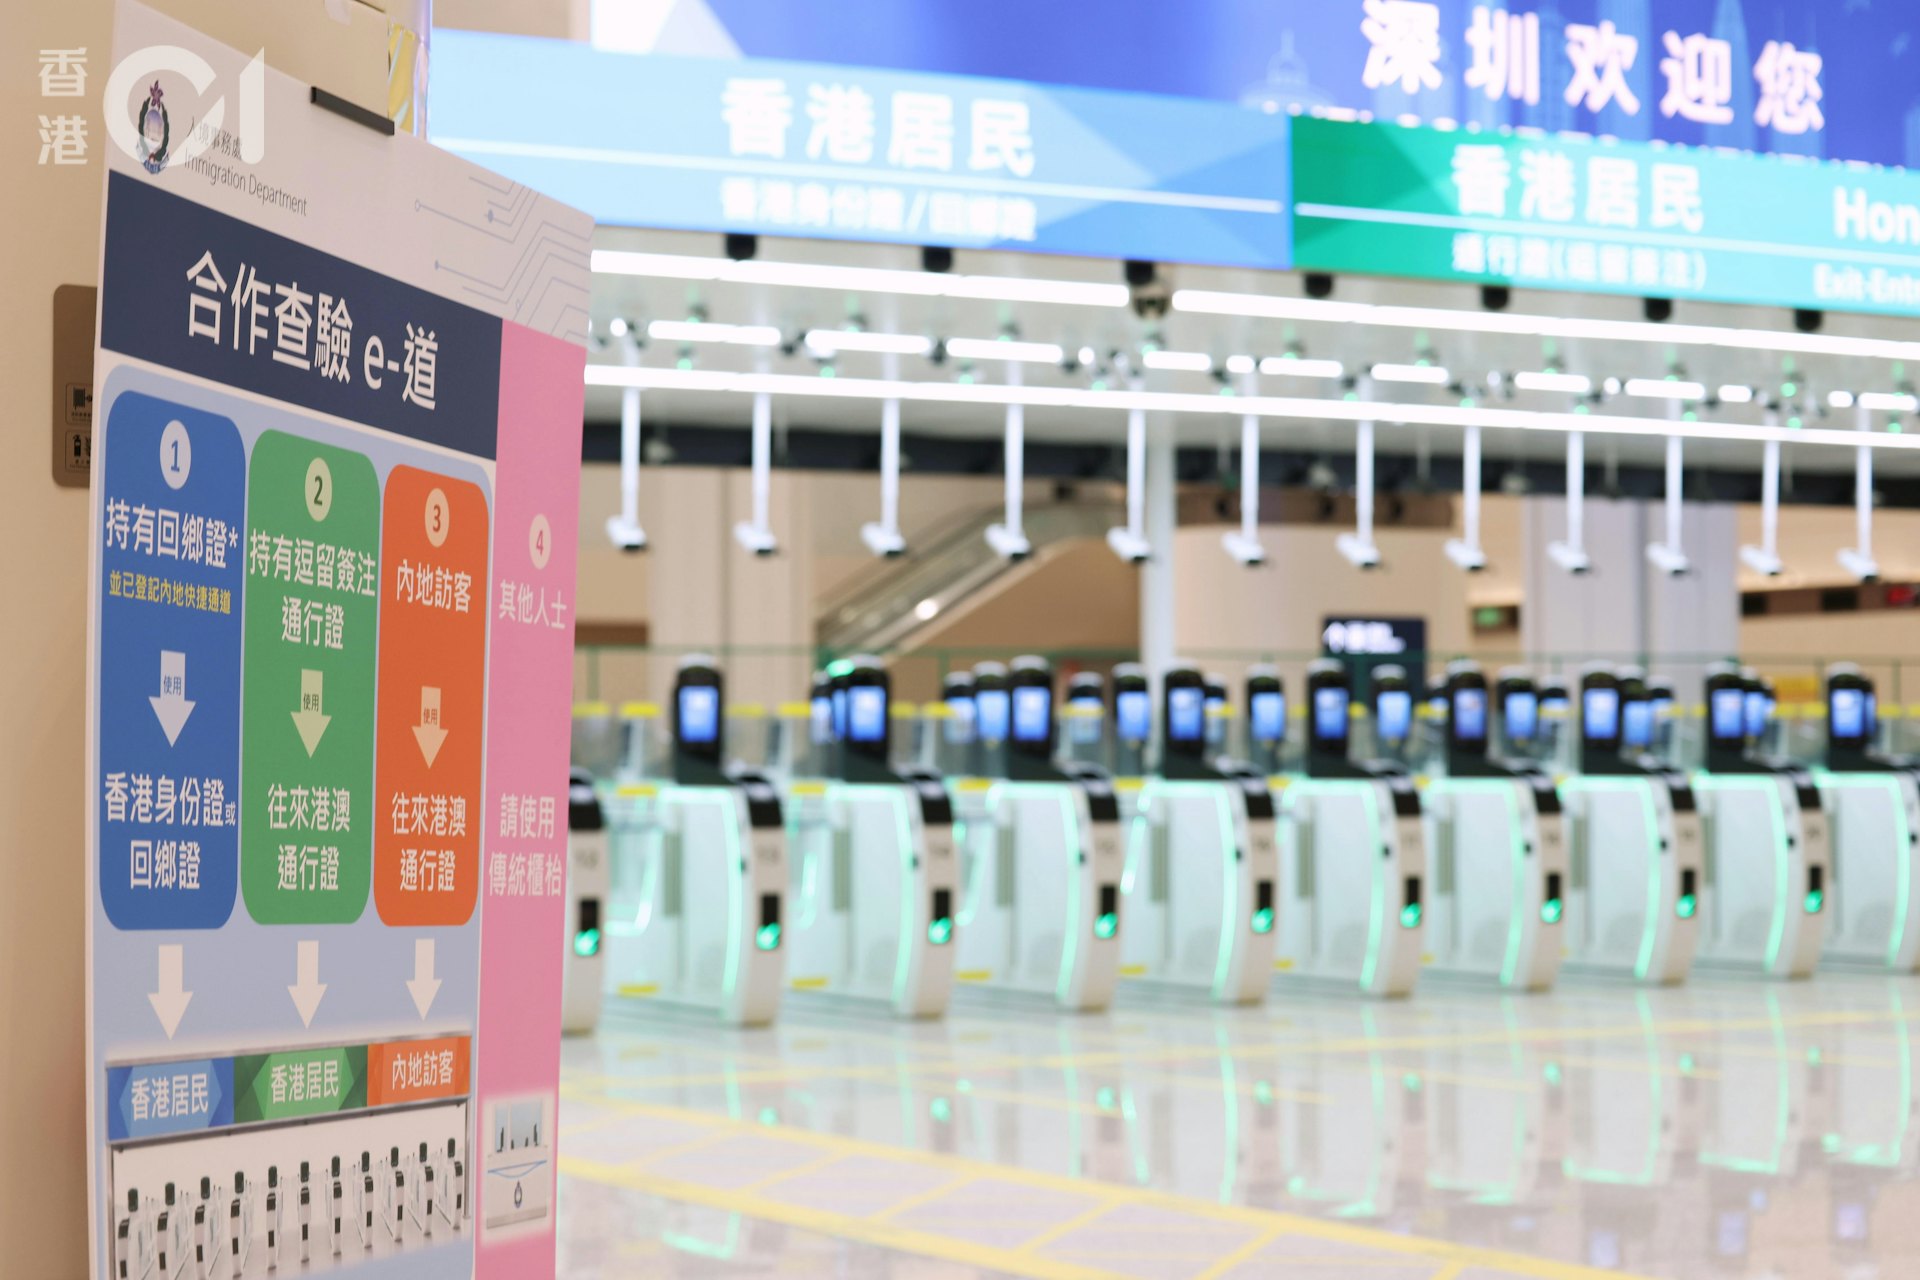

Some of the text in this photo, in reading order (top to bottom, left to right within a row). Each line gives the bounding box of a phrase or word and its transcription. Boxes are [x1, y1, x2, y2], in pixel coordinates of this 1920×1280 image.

[1361, 0, 1825, 134] 深圳欢迎您
[721, 78, 1035, 177] 香港居民
[184, 147, 307, 216] Immigration Department
[1451, 143, 1704, 233] 香港居民
[186, 250, 440, 411] 合作查驗 e-道
[170, 441, 181, 473] 1
[313, 475, 324, 506] 2
[432, 504, 441, 533] 3
[250, 528, 376, 597] 持有逗留簽注
[536, 529, 544, 556] 4
[282, 595, 344, 650] 通行證
[499, 579, 567, 630] 其他人士
[163, 675, 182, 696] 使用
[303, 693, 319, 712] 使用
[423, 708, 438, 726] 使用
[267, 783, 351, 832] 往來港澳
[392, 791, 466, 837] 往來港澳
[500, 792, 555, 839] 請使用
[130, 840, 200, 890] 回鄉證
[277, 844, 339, 891] 通行證
[400, 848, 456, 892] 通行證
[131, 1073, 209, 1121] 香港居民
[270, 1059, 339, 1104] 香港居民
